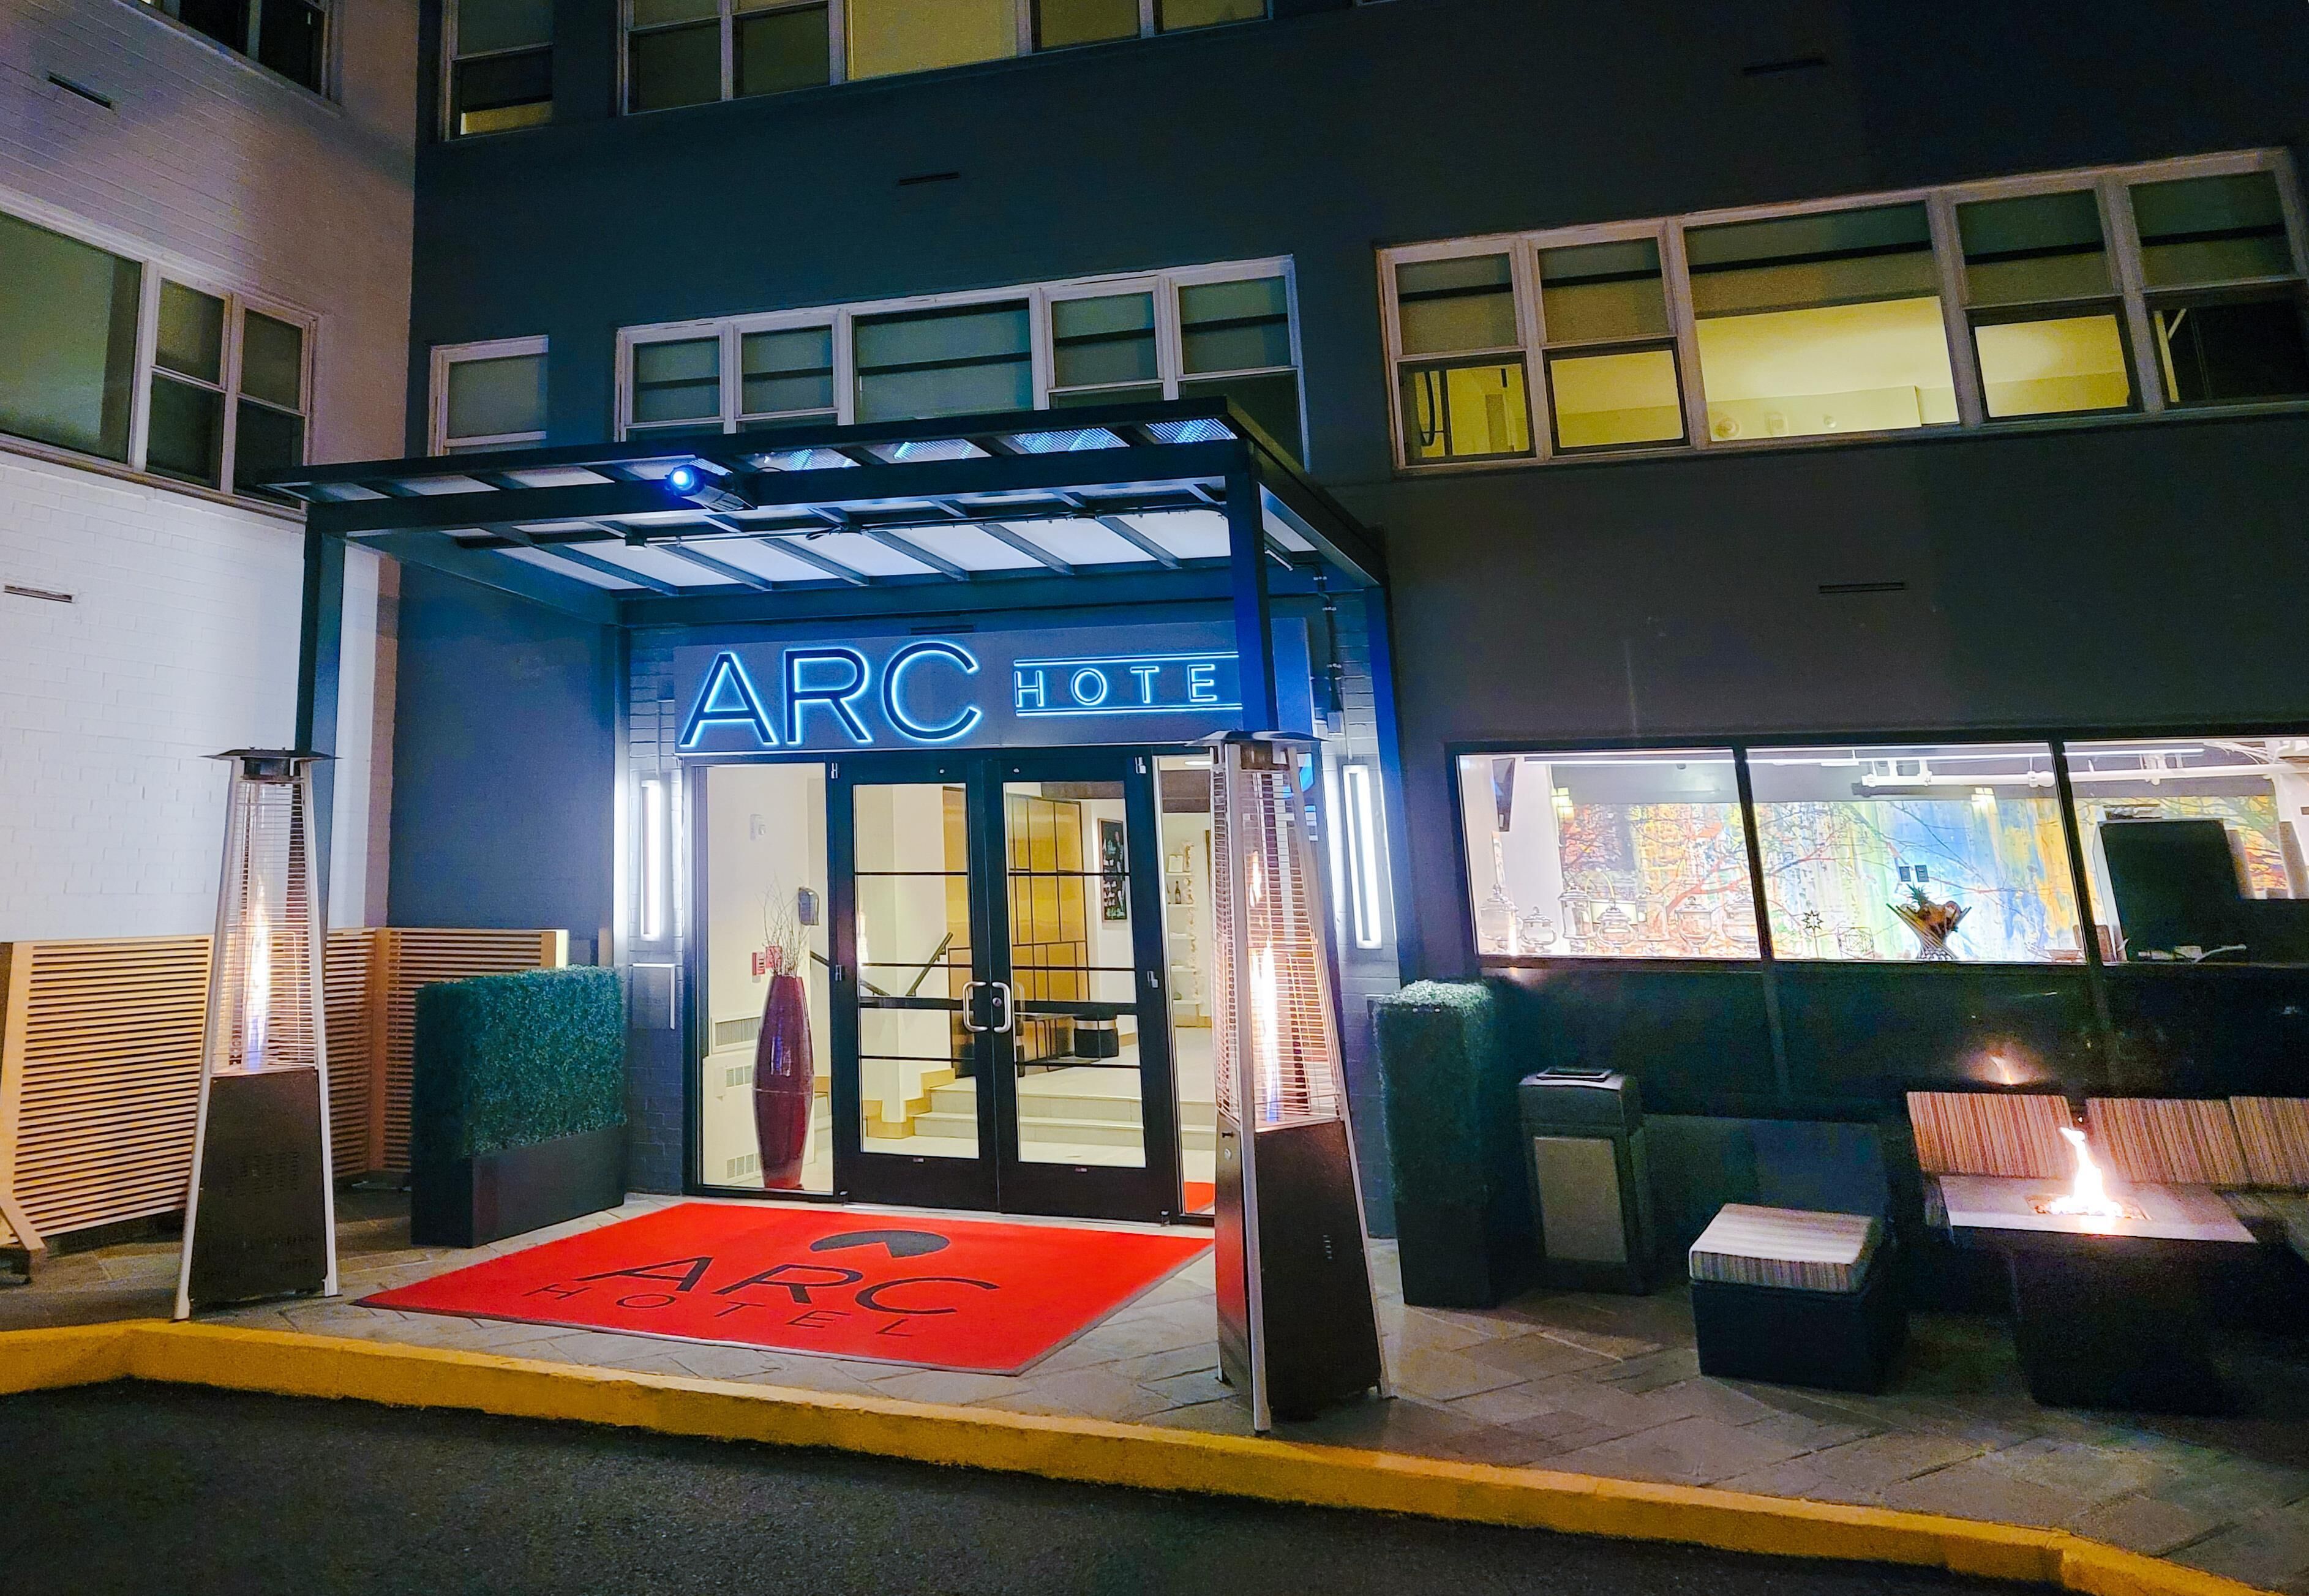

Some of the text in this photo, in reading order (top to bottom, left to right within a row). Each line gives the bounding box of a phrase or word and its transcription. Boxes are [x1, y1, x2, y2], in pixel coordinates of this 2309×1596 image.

[678, 640, 1218, 749] ARC HOTE
[522, 1283, 915, 1338] HOTEL
[576, 1256, 999, 1315] ARC
